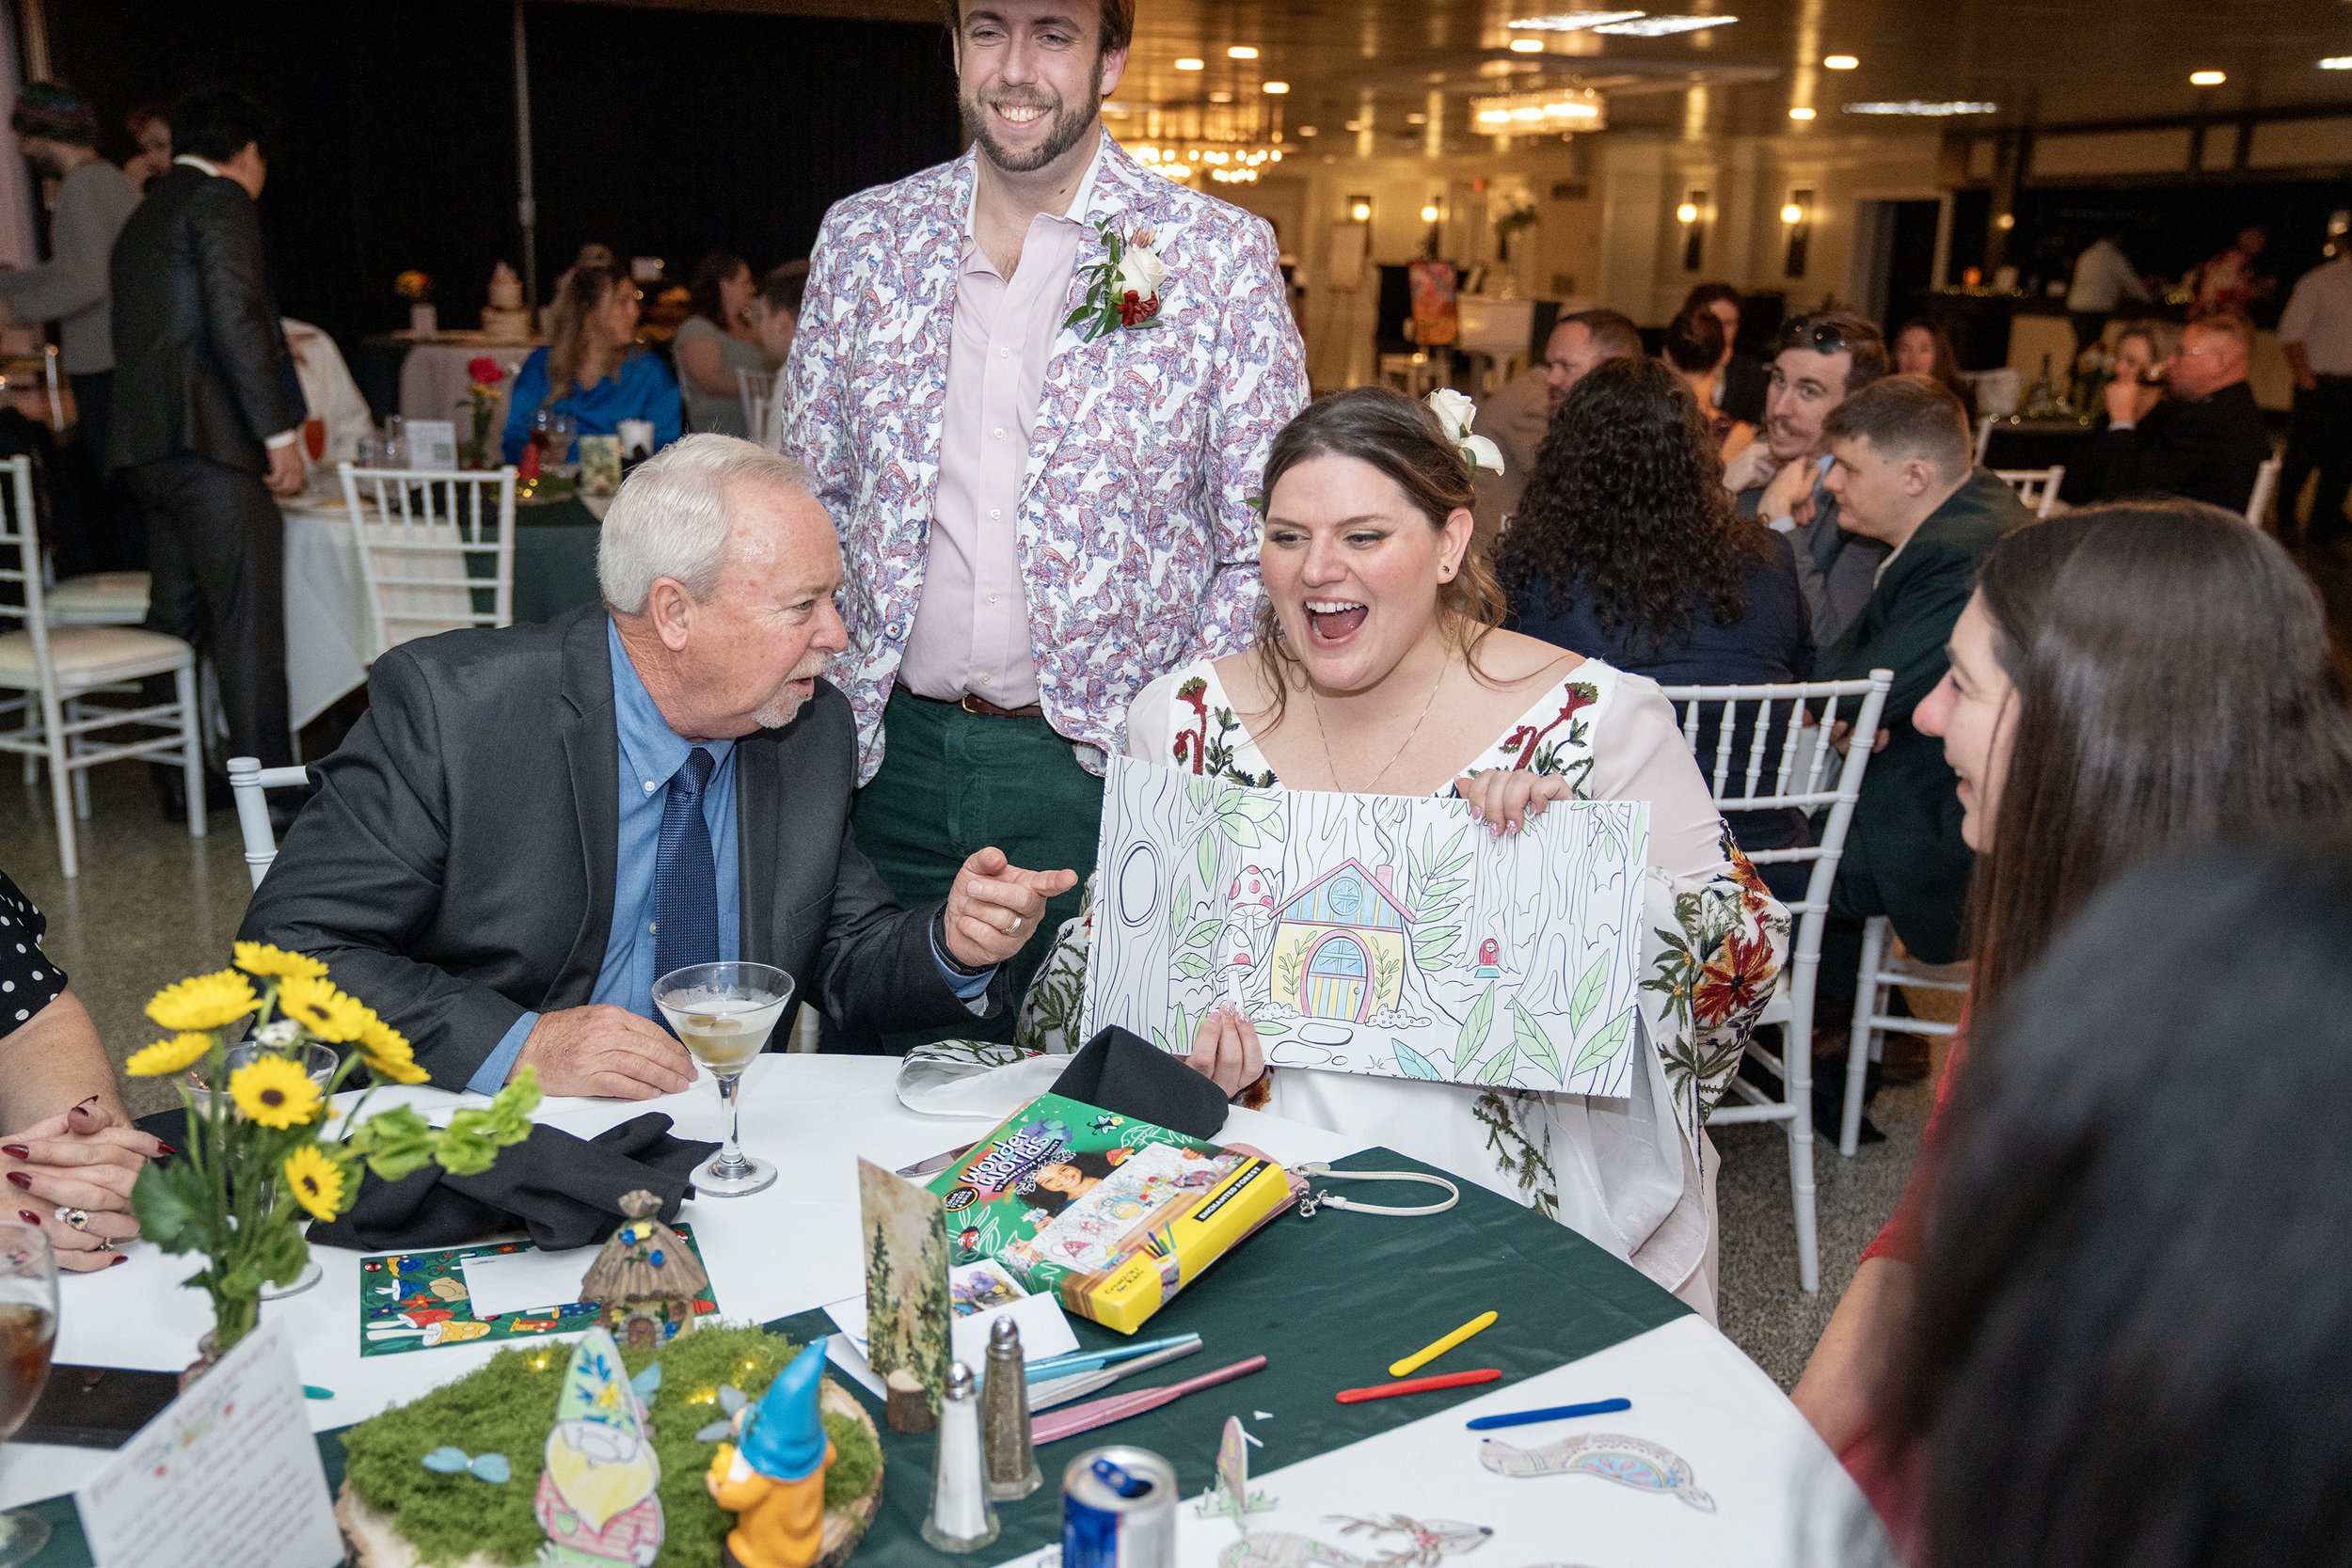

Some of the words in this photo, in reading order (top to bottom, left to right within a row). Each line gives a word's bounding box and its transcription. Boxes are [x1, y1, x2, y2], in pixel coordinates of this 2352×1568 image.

[1036, 1140, 1060, 1164] ACTIVITY
[1198, 1186, 1238, 1220] ENCHANTED
[1234, 1166, 1262, 1189] FOREST
